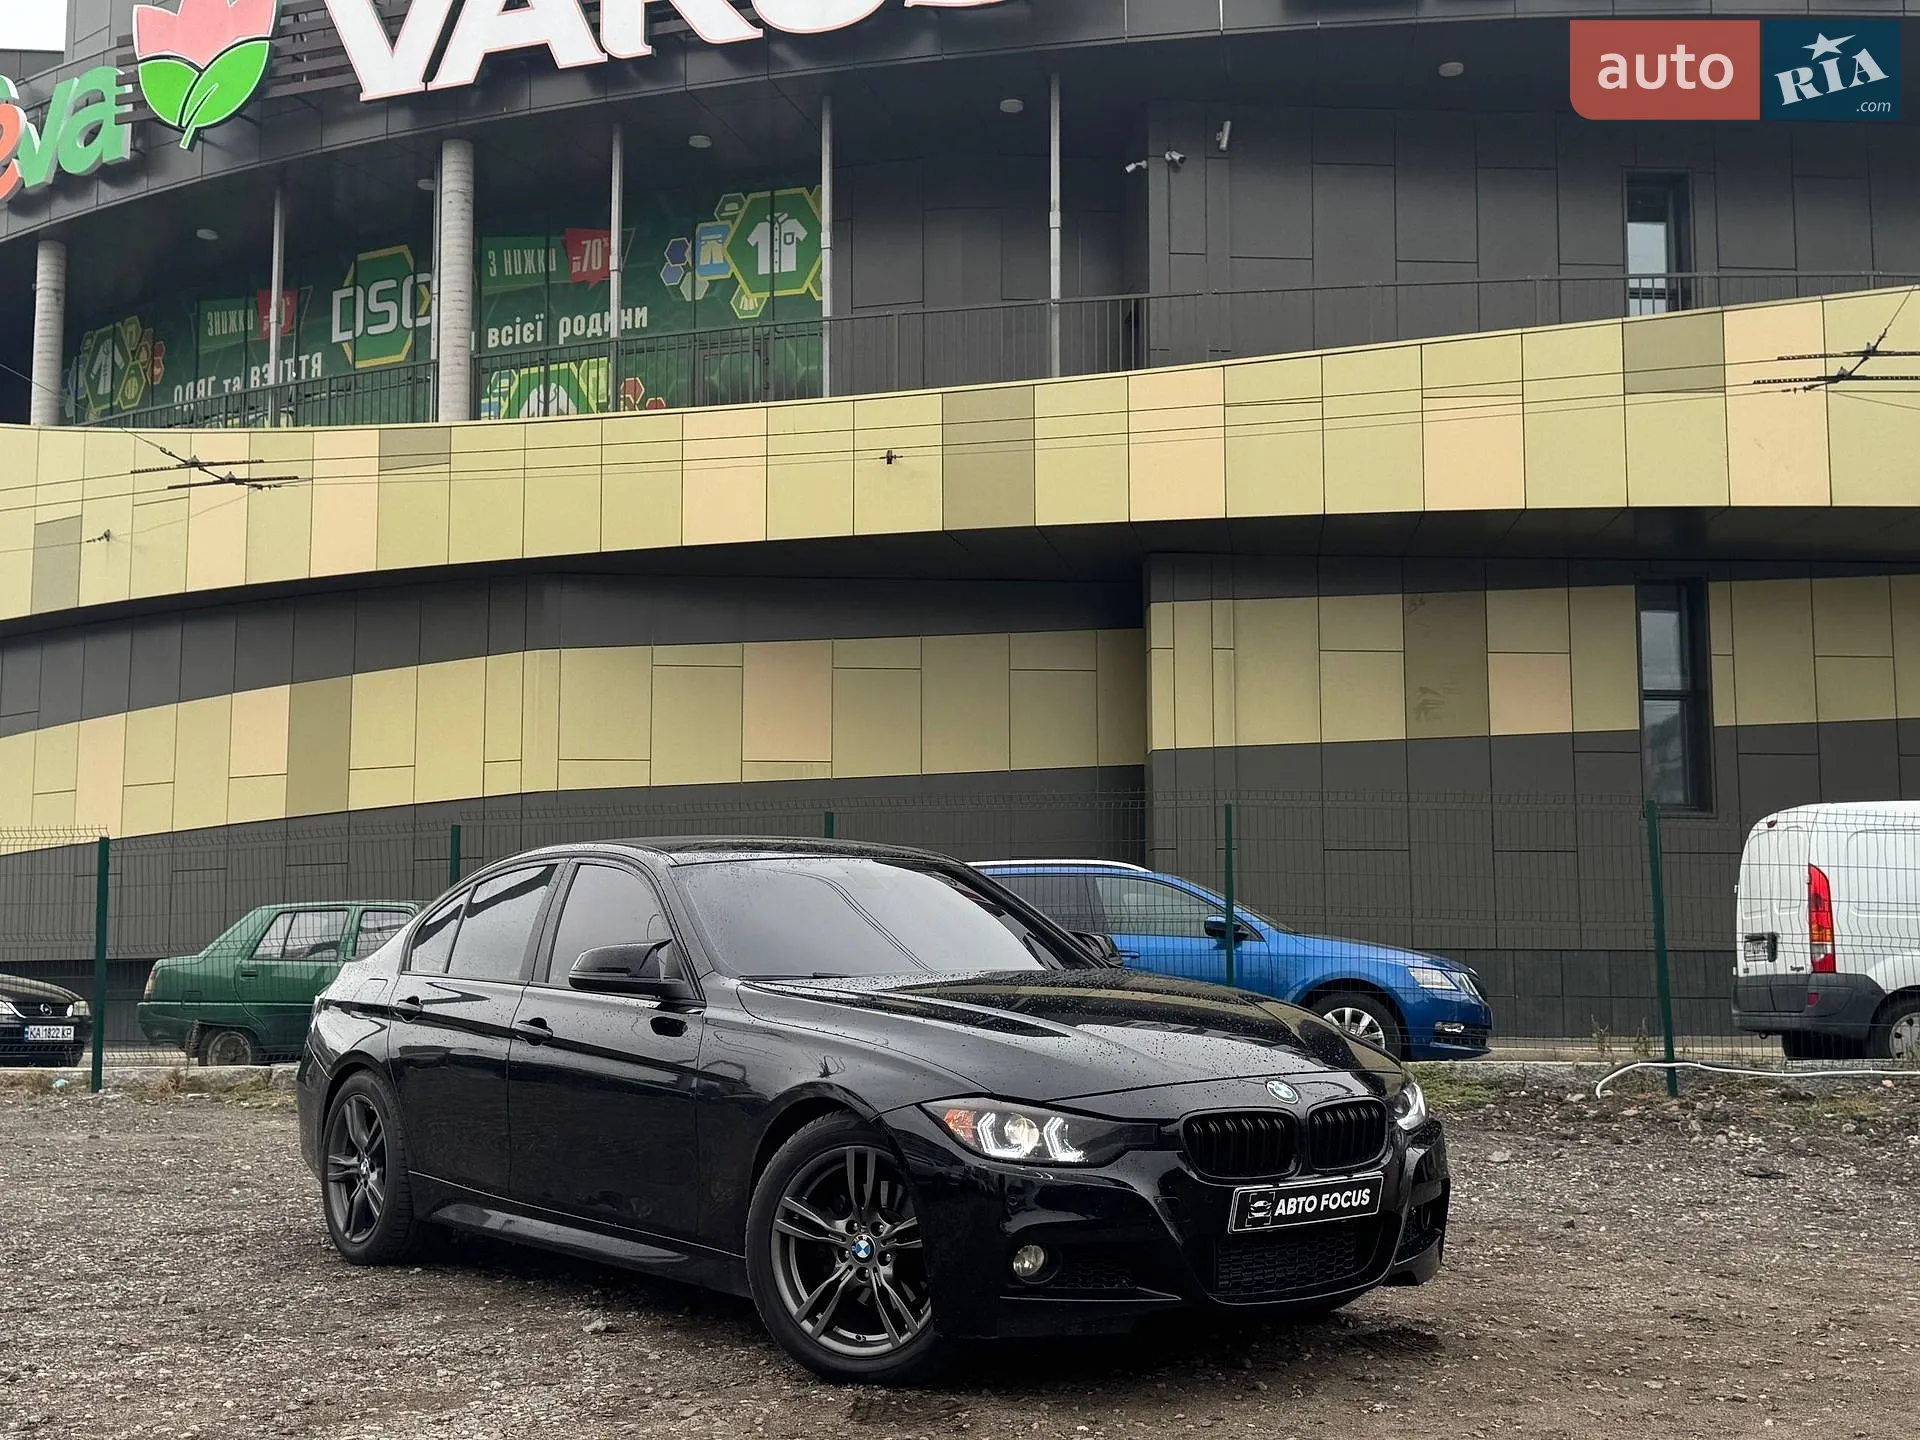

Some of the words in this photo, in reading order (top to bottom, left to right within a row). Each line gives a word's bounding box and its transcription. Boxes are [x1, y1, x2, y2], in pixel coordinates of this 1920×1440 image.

[487, 313, 545, 349] всієї
[558, 306, 648, 345] родини
[1320, 1188, 1371, 1211] FOCUS
